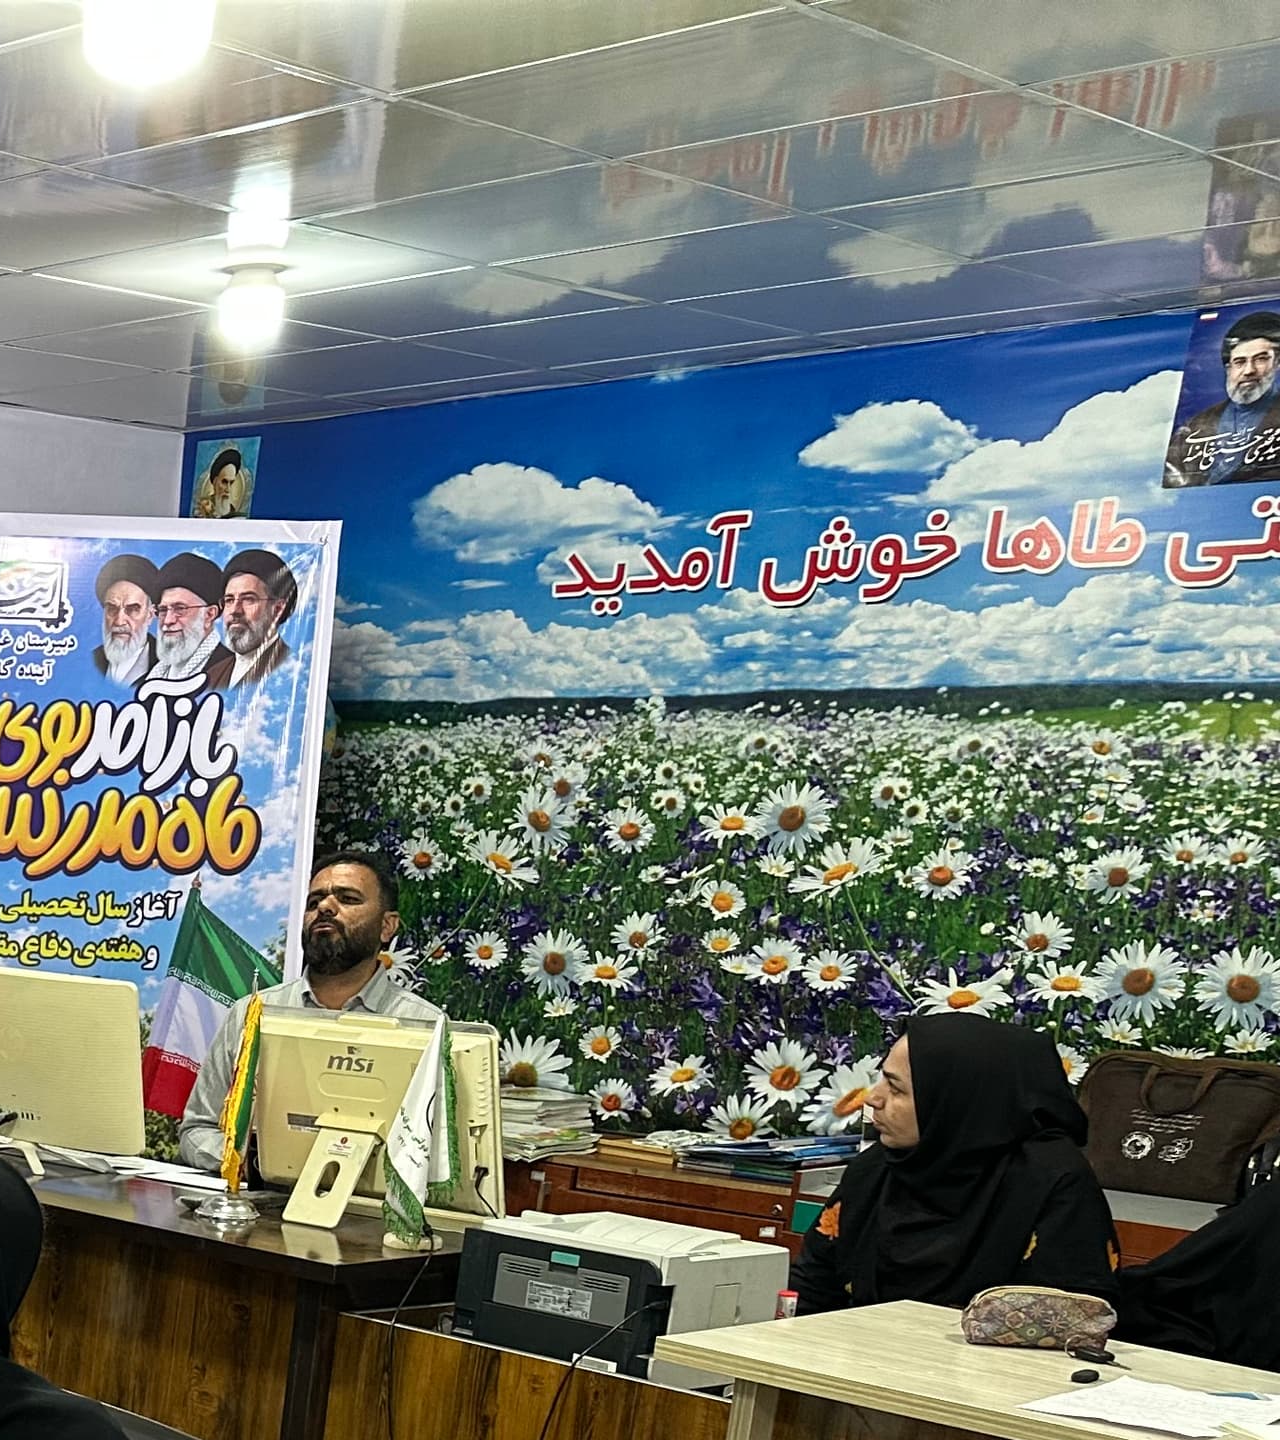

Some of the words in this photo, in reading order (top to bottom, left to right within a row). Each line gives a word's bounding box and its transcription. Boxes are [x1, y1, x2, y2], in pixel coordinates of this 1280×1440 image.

[983, 497, 1146, 572] طاها
[552, 510, 753, 614] آمدید
[760, 509, 961, 609] خوش
[15, 633, 76, 655] دبیرستان
[17, 660, 56, 683] آینده
[155, 774, 258, 871] ماه
[84, 891, 131, 924] سال
[127, 892, 181, 926] آغاز
[18, 930, 75, 966] دفاع
[142, 944, 158, 969] و
[326, 1054, 375, 1073] msi
